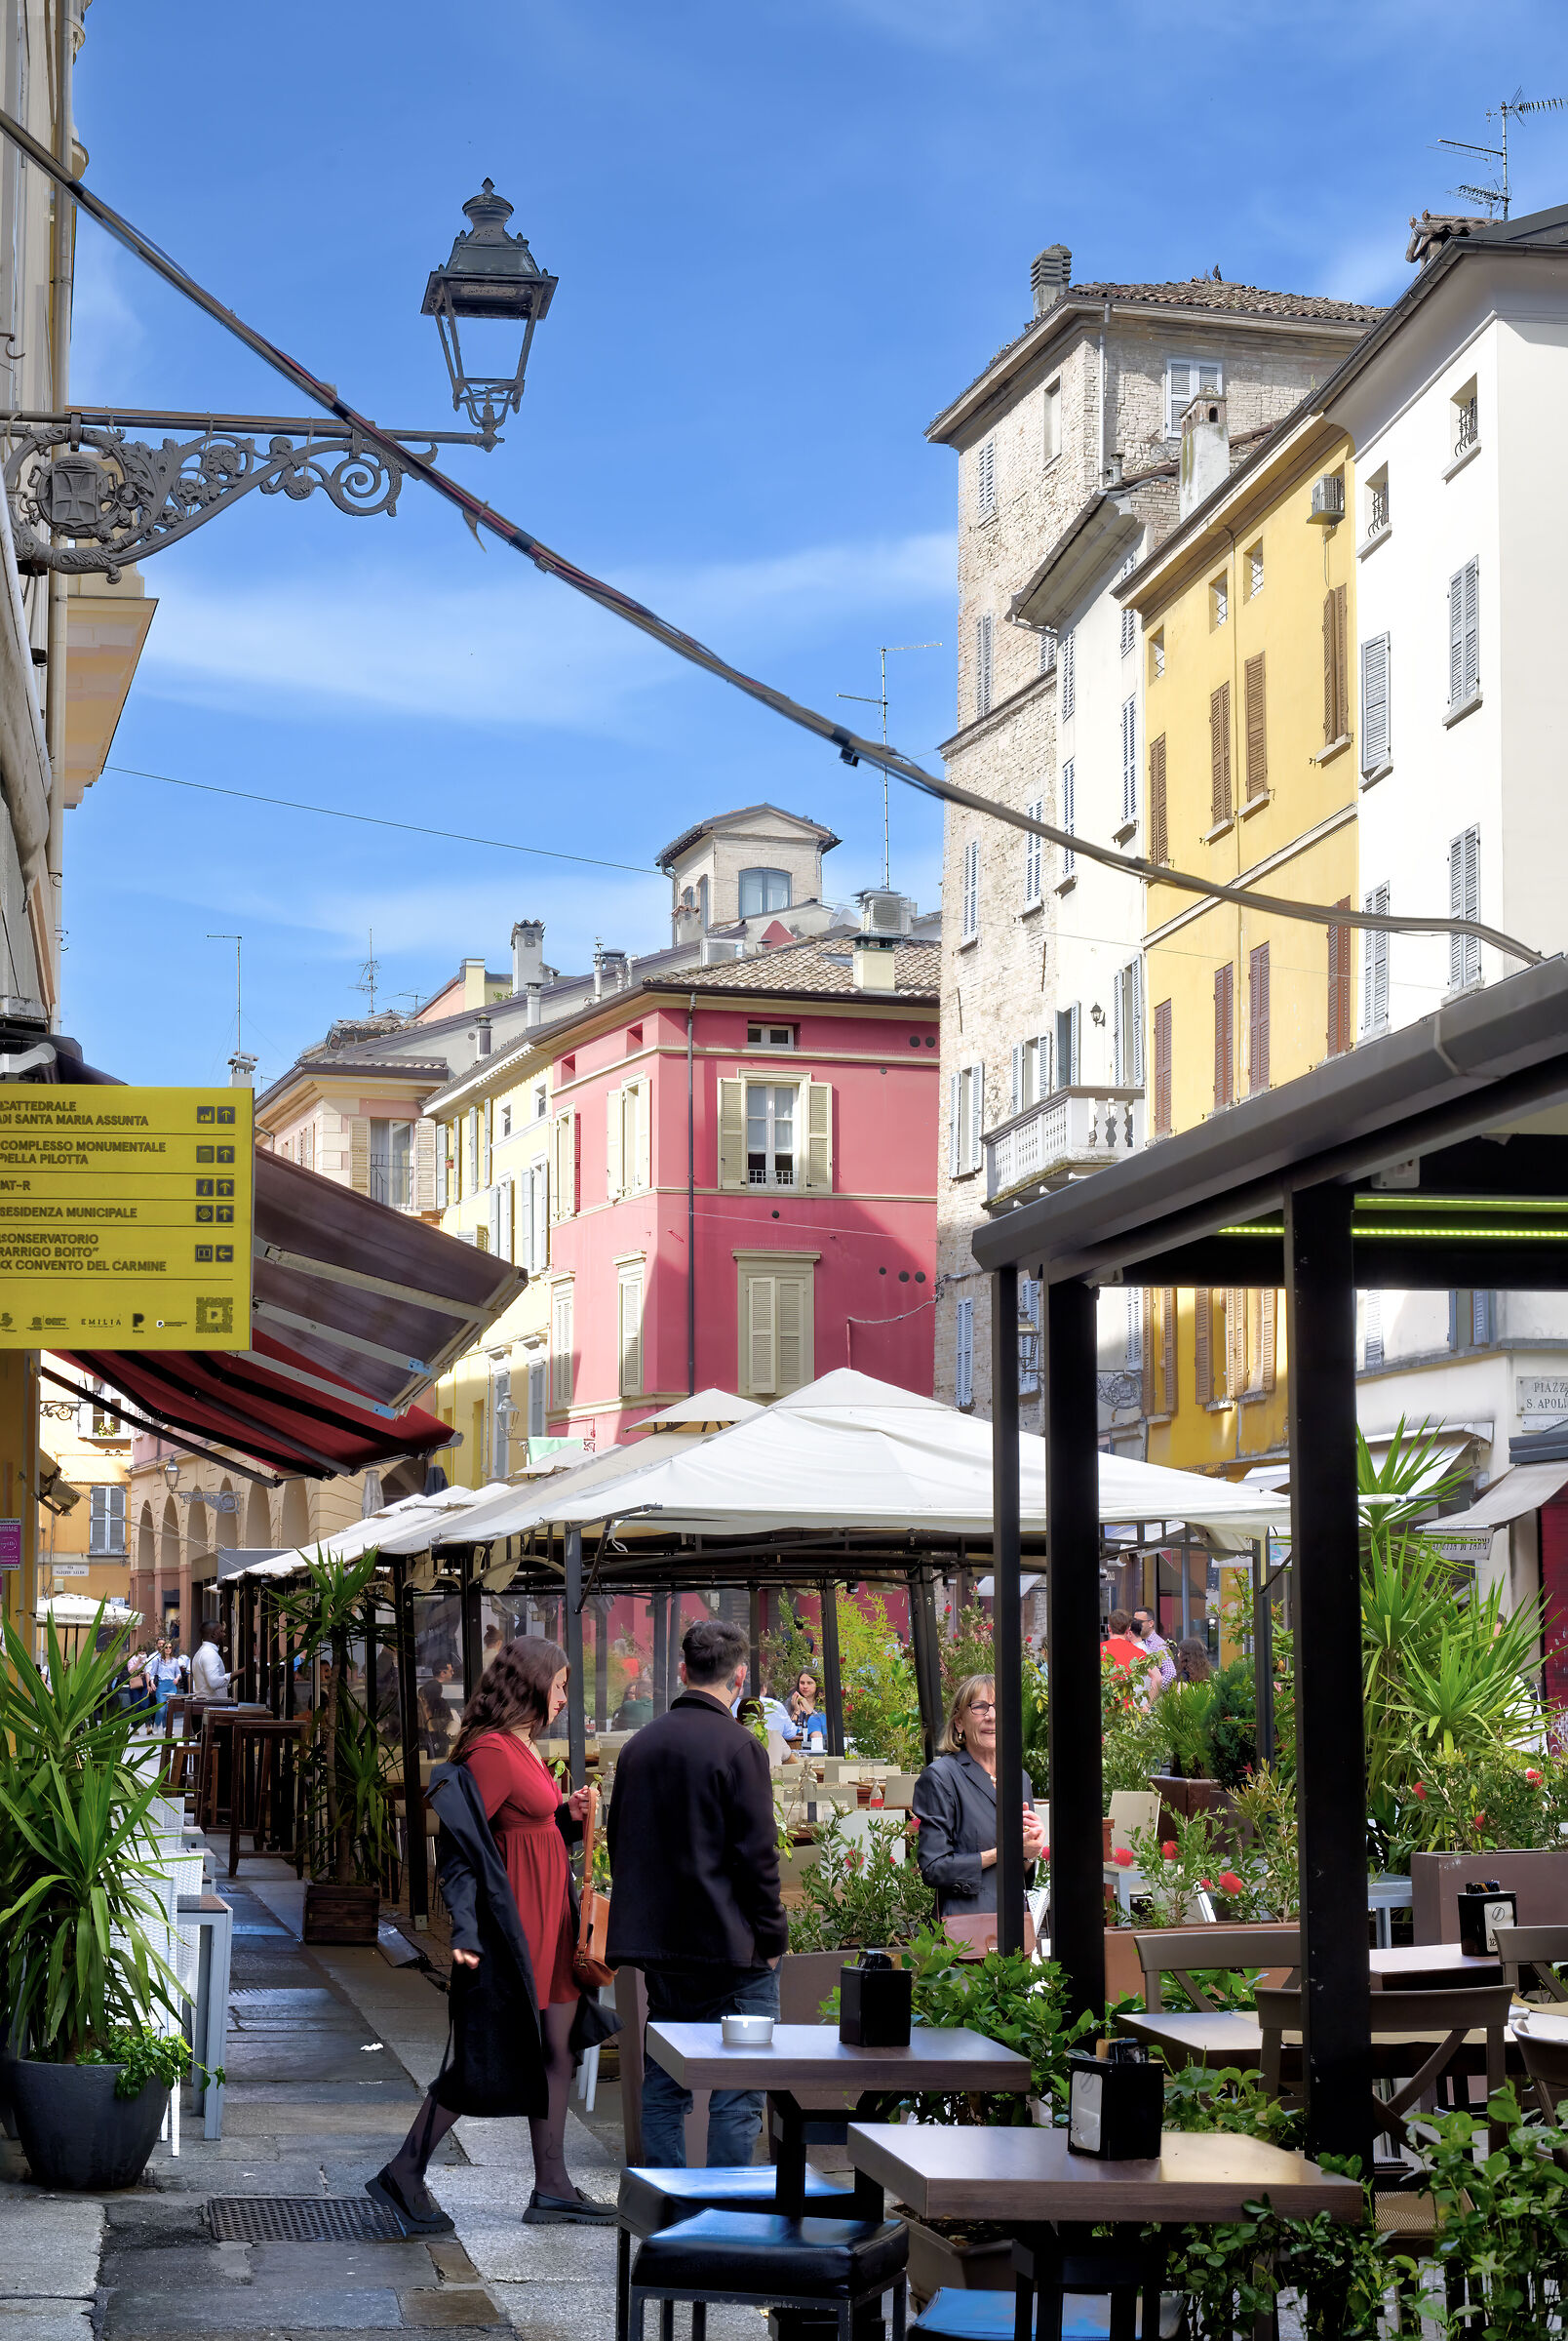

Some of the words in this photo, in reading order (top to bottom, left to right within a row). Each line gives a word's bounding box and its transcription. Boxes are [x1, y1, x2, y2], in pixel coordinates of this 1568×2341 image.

[15, 1114, 53, 1125] SANTA
[56, 1114, 94, 1126] MARIA
[96, 1115, 149, 1127] ASSUNTA
[1, 1140, 73, 1151] COMPLESSO
[76, 1141, 166, 1153] MONUMENTALE
[40, 1154, 89, 1165] PILOTTA
[66, 1208, 137, 1218] MUNICIPALE
[16, 1260, 84, 1271] CONVENTO
[87, 1260, 109, 1271] DEL
[112, 1260, 167, 1272] CARMINE
[1533, 1381, 1568, 1394] PIAZZ
